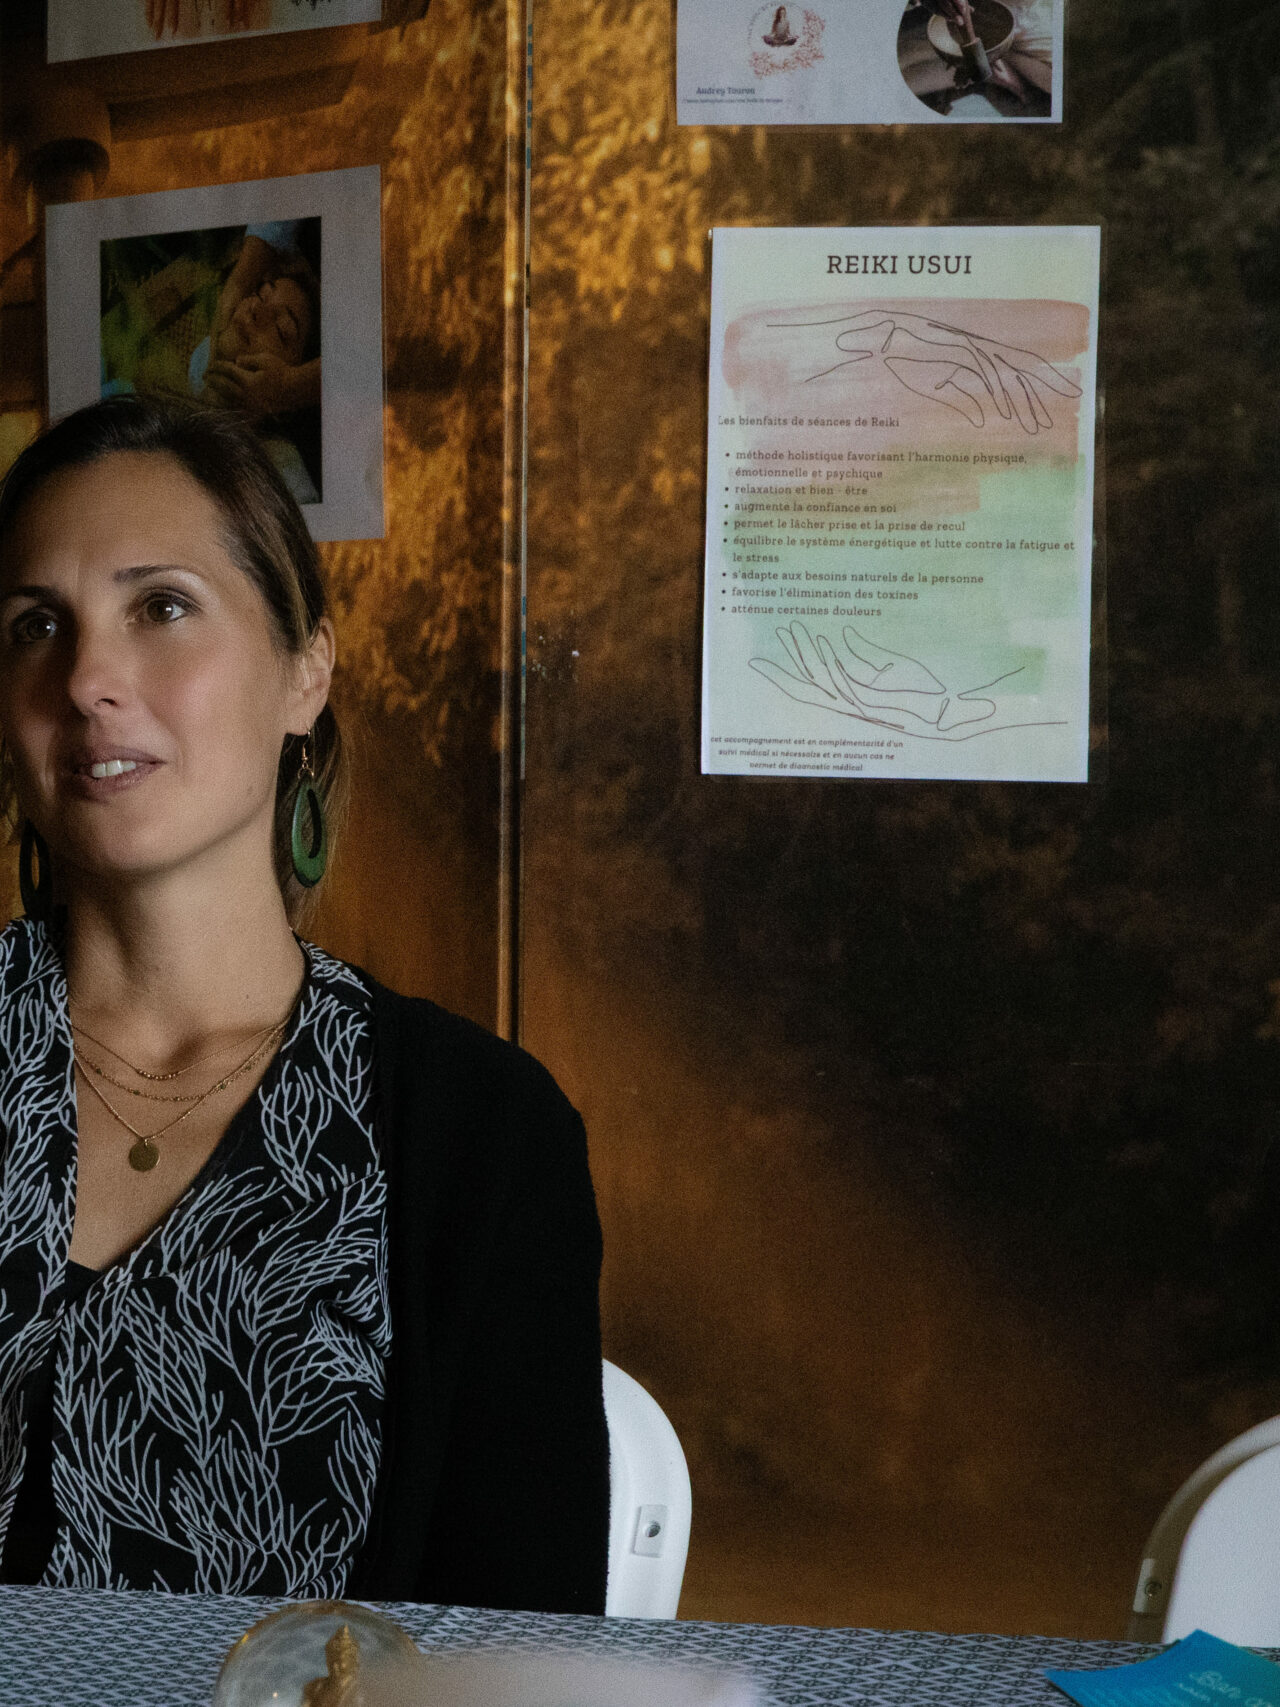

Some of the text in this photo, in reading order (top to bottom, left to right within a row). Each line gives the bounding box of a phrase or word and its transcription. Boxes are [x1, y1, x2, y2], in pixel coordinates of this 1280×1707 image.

[696, 87, 725, 96] Audrey
[827, 255, 972, 274] REIKI USUI
[718, 416, 899, 427] Les bienfaits de séances de Reiki
[736, 451, 1027, 465] méthode holistique favorisant l'harmonie physique,
[735, 468, 883, 480] émotionnelle et psychique
[735, 484, 792, 495] relaxation
[795, 485, 806, 495] et
[810, 485, 834, 495] bien
[734, 502, 896, 513] augmente la confiance en soi
[734, 519, 965, 532] permet le lâcher prise et la prise de recul
[733, 536, 1075, 552] équilibre le système énergétique et lutte contre la fatigue et
[733, 553, 779, 563] le stress
[732, 570, 984, 585] s'adapte aux besoins naturels de la personne
[732, 587, 918, 600] favorise l'élimination des toxines
[732, 604, 882, 616] atténue certaines douleurs
[724, 736, 791, 745] accompagnement
[740, 749, 769, 757] médical
[832, 763, 863, 771] médical
